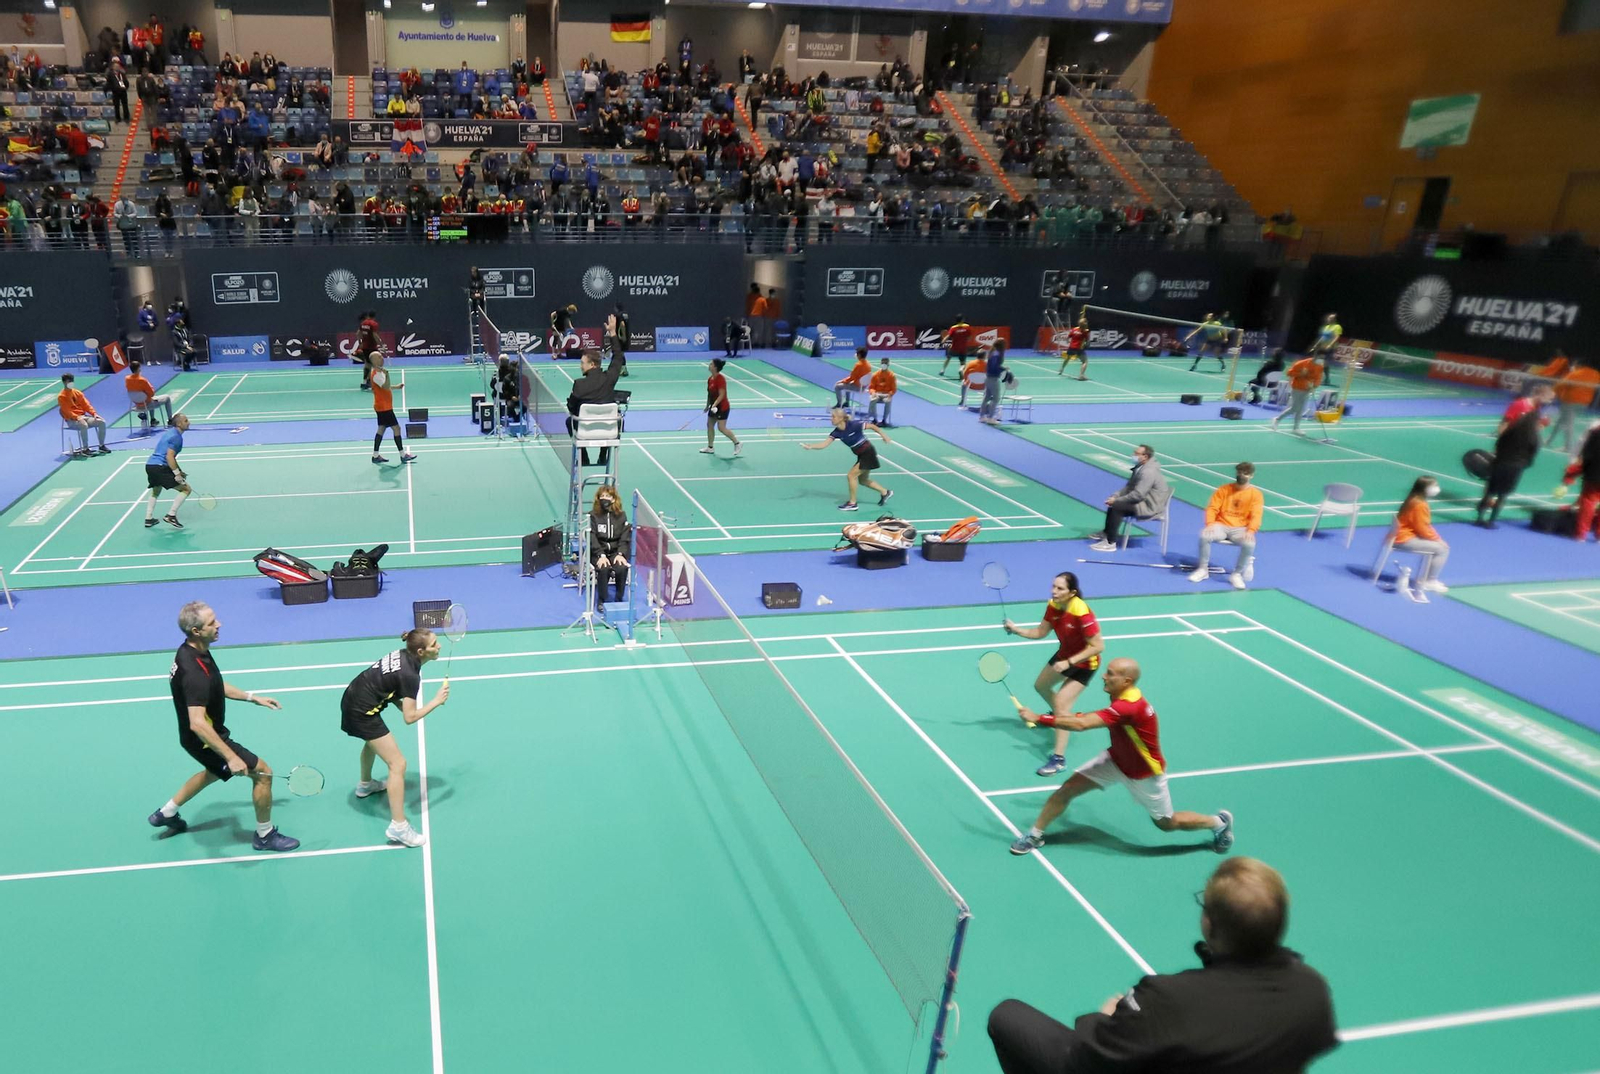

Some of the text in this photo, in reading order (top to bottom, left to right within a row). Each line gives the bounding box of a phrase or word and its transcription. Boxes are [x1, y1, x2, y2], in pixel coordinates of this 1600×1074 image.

[398, 31, 496, 42] Ayuntamiento de Huelva
[444, 125, 493, 135] HUELVA'21
[453, 134, 484, 142] ESPAÑA
[363, 277, 429, 289] HUELVA'21
[619, 274, 680, 286] HUELVA'21
[952, 277, 1008, 288] HUELVA'21
[376, 288, 417, 298] ESPAÑA
[629, 286, 669, 295] ESPAÑA
[961, 287, 996, 296] ESPAÑA
[1456, 296, 1580, 325] HUELVA'21
[1469, 319, 1544, 341] ESPAÑA
[1435, 360, 1496, 380] TOYOTA
[483, 408, 491, 417] 5
[677, 585, 688, 599] 2
[673, 598, 691, 606] MINS
